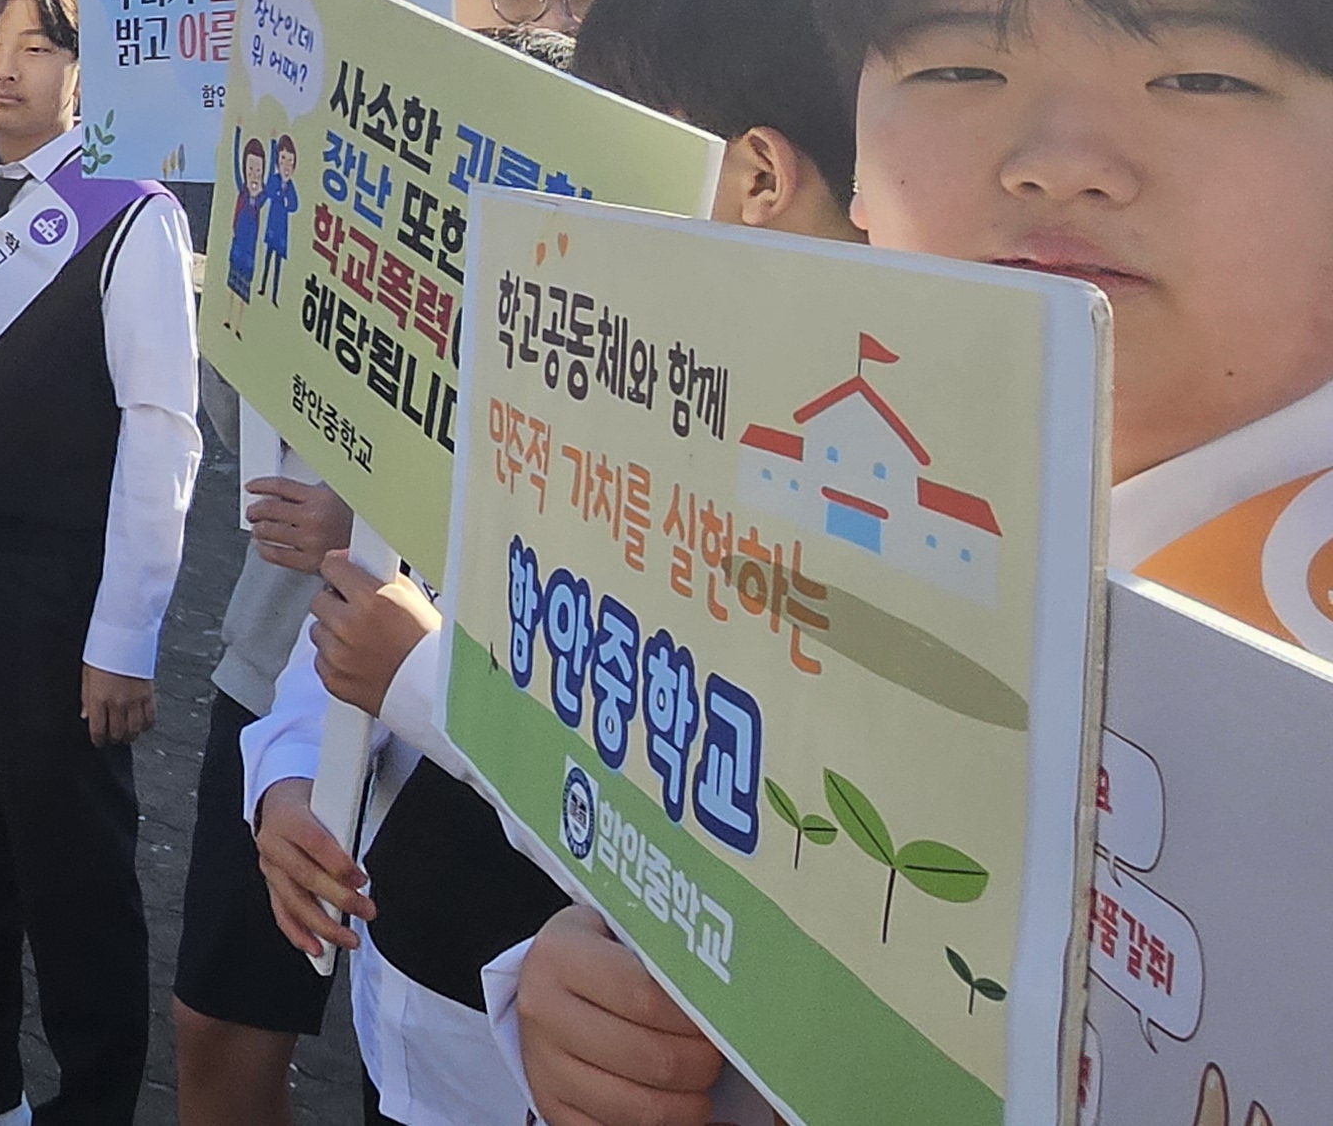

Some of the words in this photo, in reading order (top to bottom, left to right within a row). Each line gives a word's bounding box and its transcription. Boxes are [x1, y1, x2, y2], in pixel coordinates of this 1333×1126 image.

[115, 16, 171, 66] 밝고
[178, 10, 237, 62] 아름
[252, 34, 265, 66] 뭐
[269, 50, 308, 93] 어때?
[330, 59, 442, 175] 사소한
[321, 129, 392, 229] 장난
[312, 202, 462, 370] 학교폭력
[291, 373, 373, 475] 함안중학교
[668, 341, 728, 441] 함께
[562, 443, 652, 573] 가치를
[663, 482, 831, 675] 실현하는
[509, 534, 763, 858] 함안중학교
[597, 800, 733, 985] 함안중학교
